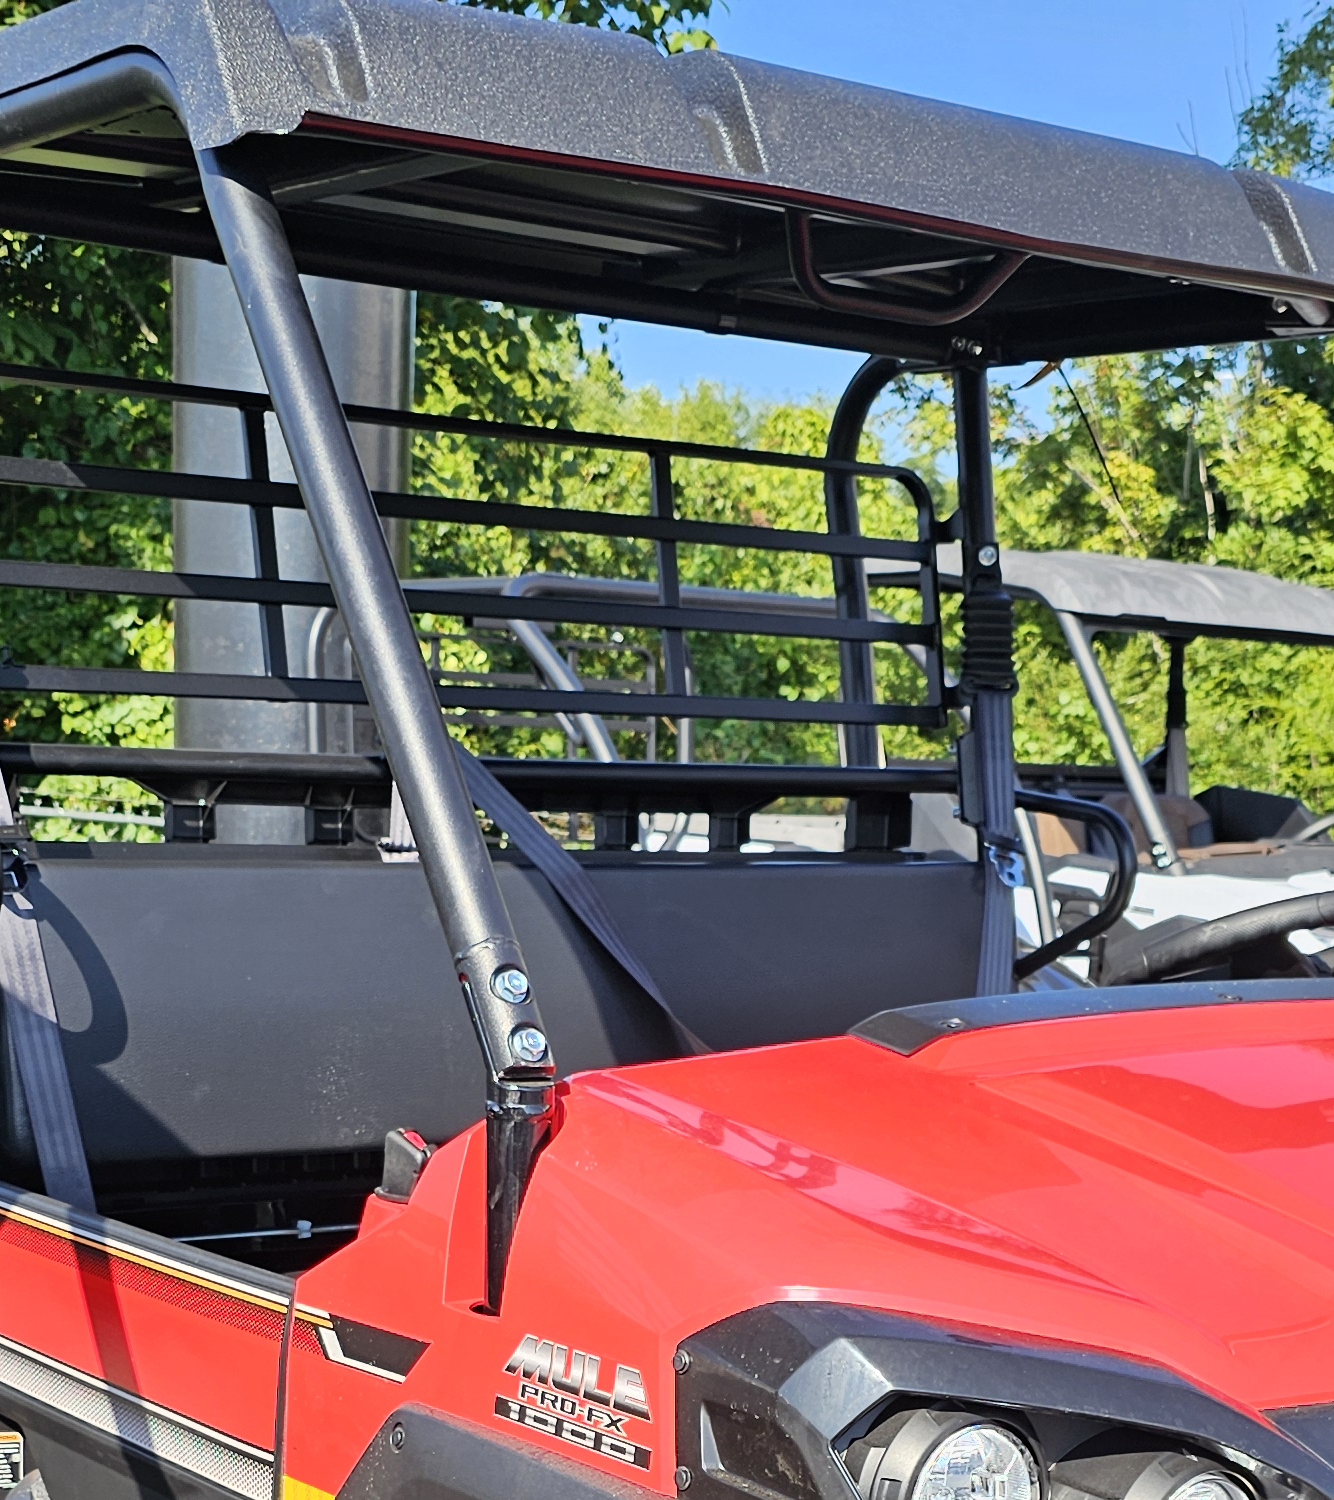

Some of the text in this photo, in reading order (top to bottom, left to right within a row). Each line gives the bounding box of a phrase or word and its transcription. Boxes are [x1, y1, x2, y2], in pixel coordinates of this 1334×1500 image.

[503, 1334, 653, 1423] MULE
[508, 1401, 636, 1463] 1000
[520, 1383, 629, 1437] PRO-FX
